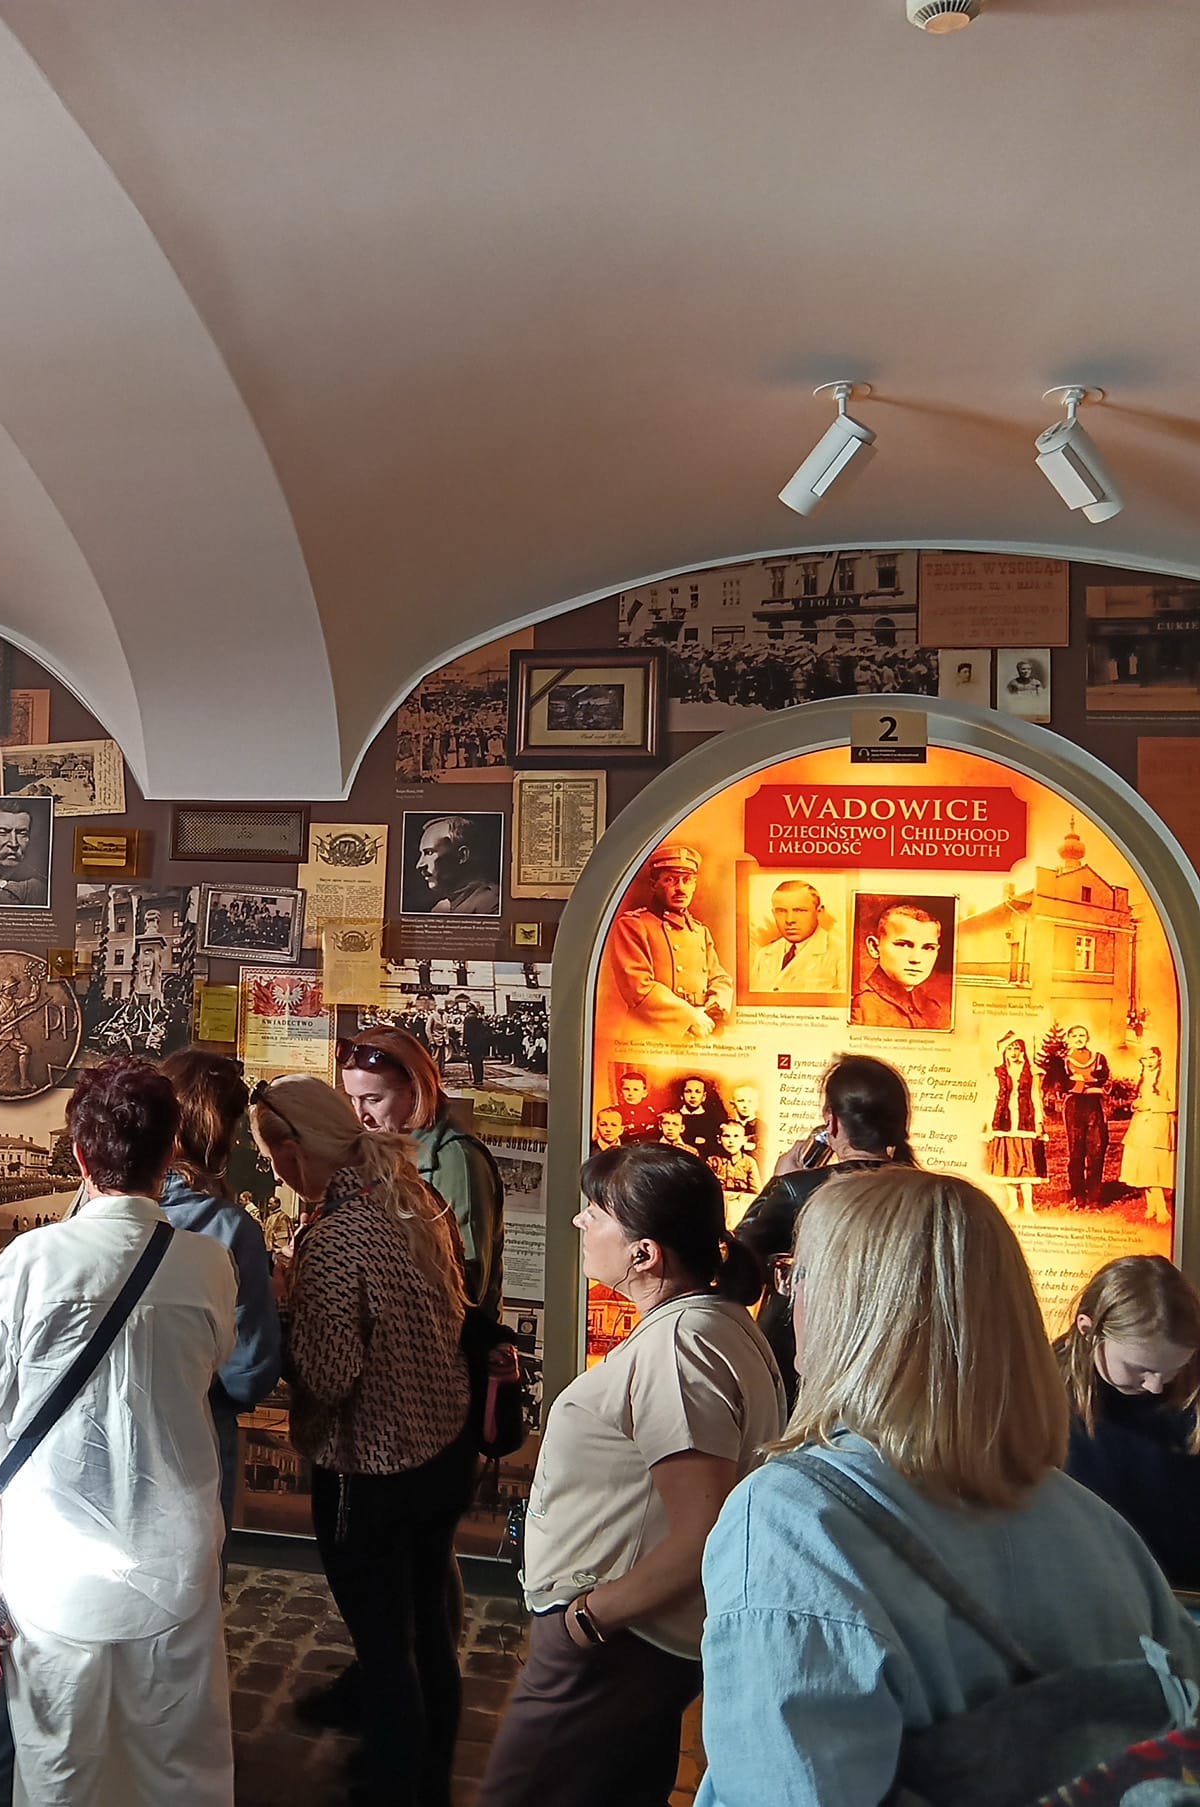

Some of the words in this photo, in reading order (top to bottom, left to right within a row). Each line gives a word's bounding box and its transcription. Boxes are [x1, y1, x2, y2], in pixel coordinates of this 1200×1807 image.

[878, 716, 899, 742] 2
[782, 794, 988, 821] WADOWICE
[768, 821, 887, 840] DZIECIŃSTWO
[900, 825, 1010, 842] CHILDHOOD
[768, 842, 774, 853] I
[778, 838, 862, 856] MŁODOŚĆ
[899, 844, 939, 856] AND
[942, 844, 1001, 857] YOUTH
[928, 1063, 952, 1073] domu
[779, 1070, 823, 1084] rodzinneg
[919, 1091, 944, 1102] przez
[911, 1103, 946, 1114] niazda,
[1044, 1266, 1058, 1277] the
[1059, 1267, 1093, 1279] threshol
[1041, 1281, 1069, 1292] thanks
